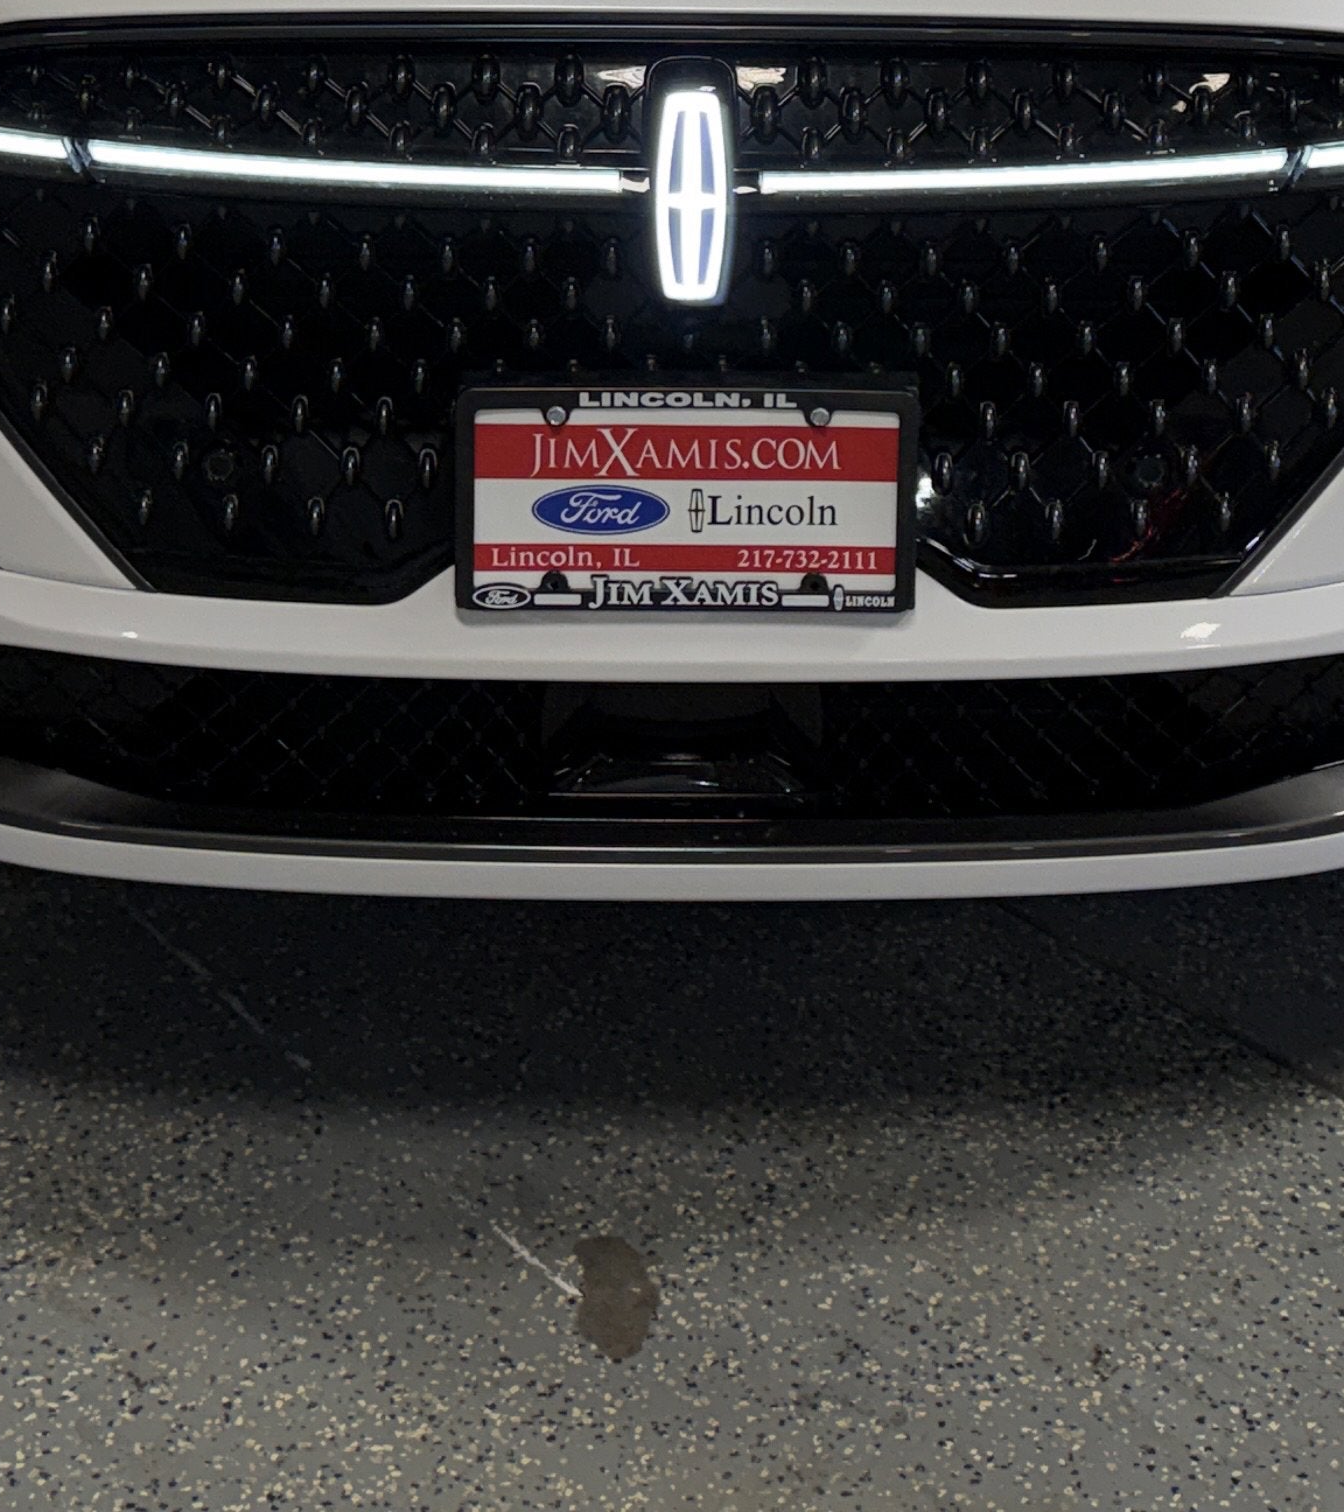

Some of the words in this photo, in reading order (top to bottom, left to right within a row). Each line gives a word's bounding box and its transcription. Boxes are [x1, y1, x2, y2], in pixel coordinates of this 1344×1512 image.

[763, 392, 797, 408] IL
[560, 494, 642, 525] Ford
[707, 495, 839, 527] Lincoln
[491, 547, 602, 568] Lincoln,
[614, 548, 640, 568] IL
[737, 550, 878, 570] 217-732-2111
[588, 576, 653, 609] JIM
[660, 577, 779, 607] XAMIS
[846, 595, 895, 607] LINCOLN
